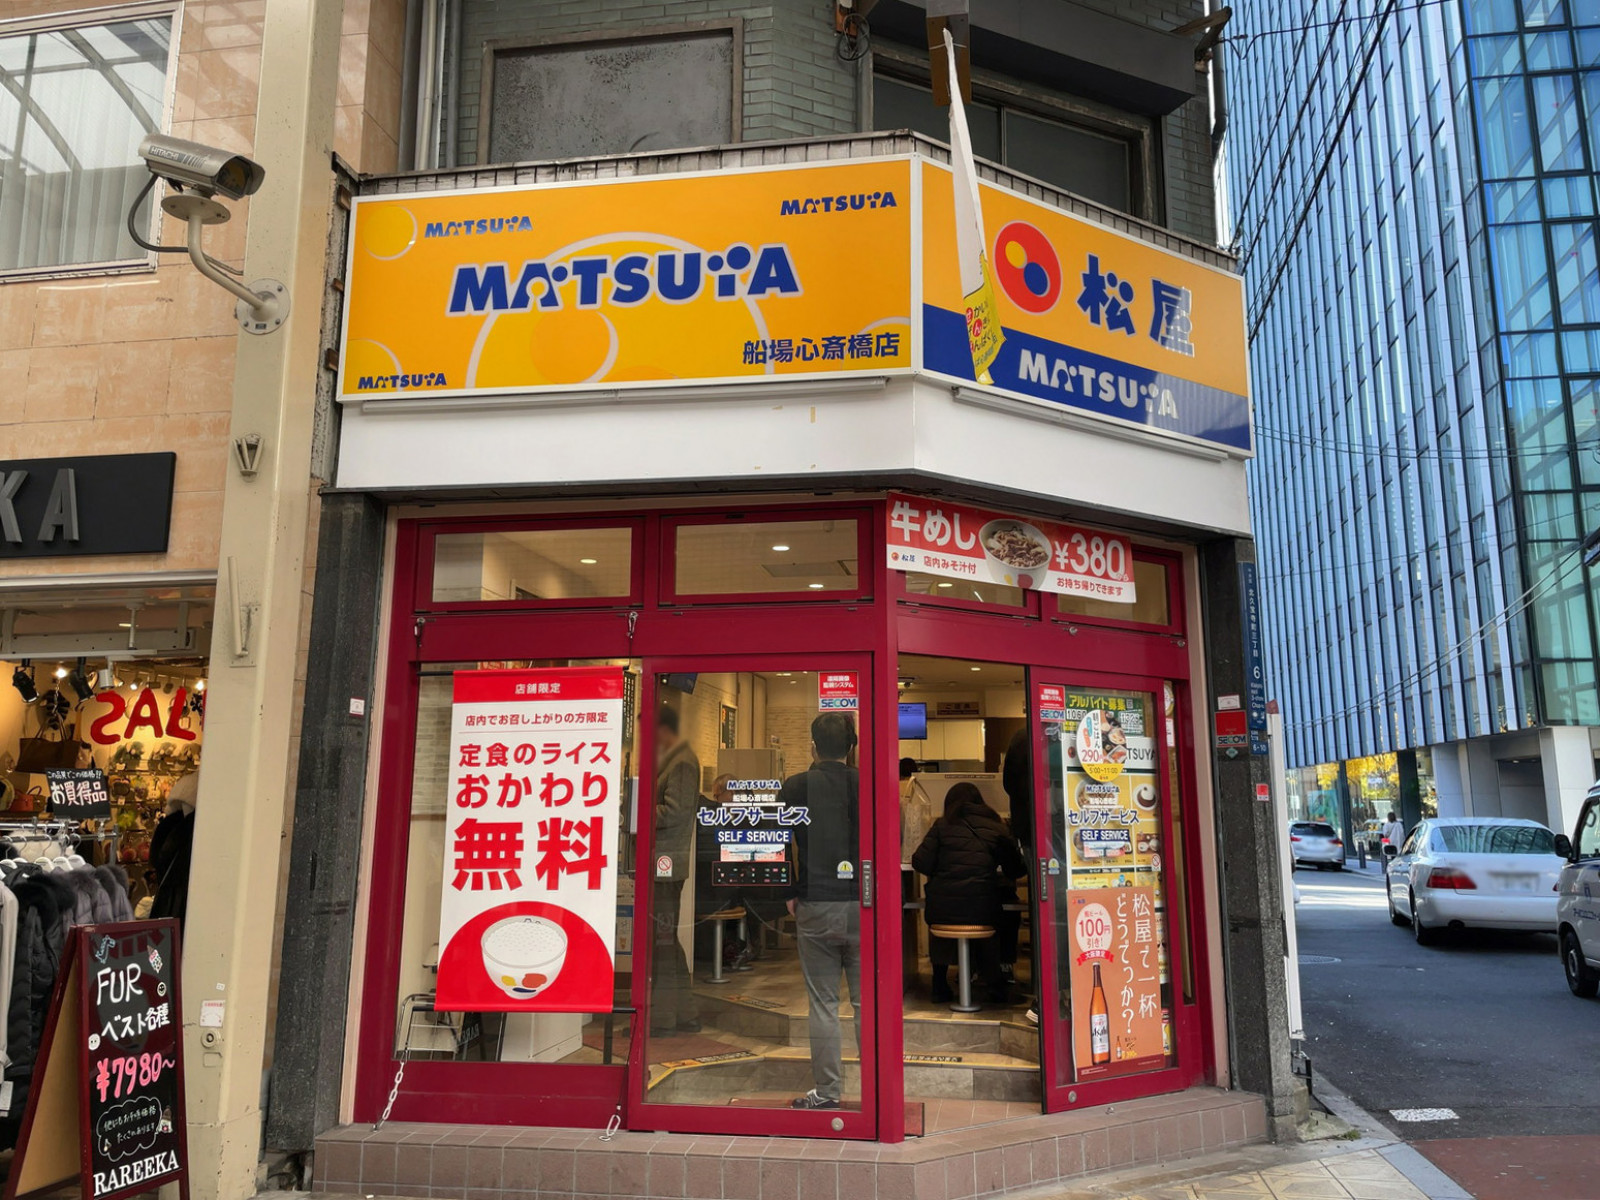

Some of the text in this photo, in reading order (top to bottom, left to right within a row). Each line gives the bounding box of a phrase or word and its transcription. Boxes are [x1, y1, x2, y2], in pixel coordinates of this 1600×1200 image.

[150, 146, 179, 161] HITACHI
[780, 191, 898, 216] MATSUYA
[425, 216, 533, 238] MATSUYA
[447, 244, 801, 315] MATSUYA
[1076, 252, 1195, 358] 松屋
[742, 332, 901, 364] 船場心斎橋店
[358, 372, 447, 389] MATSUYA
[1018, 348, 1179, 420] MATSUYA
[890, 500, 976, 550] 牛めし
[923, 555, 977, 575] 店内みそ汁付
[1054, 532, 1126, 580] ¥380
[1056, 577, 1124, 597] お持ち帰りできます
[1253, 665, 1260, 679] 6
[514, 682, 561, 695] 店舗限定
[821, 698, 857, 708] SECOM
[1069, 694, 1126, 711] アルバイト募集
[465, 711, 608, 727] 店内でお召し上がりの方限定
[1040, 710, 1065, 719] SECOM
[1218, 735, 1246, 744] SECOM
[458, 741, 612, 768] 定食のライス
[1127, 747, 1156, 761] TSUYA
[50, 780, 107, 806] お買得品
[455, 771, 608, 809] おかわり
[727, 780, 781, 790] MATSUYA
[697, 807, 811, 826] セルフサービス
[1067, 809, 1140, 825] セルフサービス
[718, 831, 789, 842] SELF SERVICE
[1081, 830, 1129, 841] SELF SERVICE
[451, 816, 608, 891] 無料
[1079, 918, 1111, 937] 100円
[1131, 893, 1158, 1018] 松屋で一杯
[97, 962, 144, 1005] FUR
[101, 1002, 170, 1042] ベスト各種
[93, 1149, 180, 1196] RAREEKA
